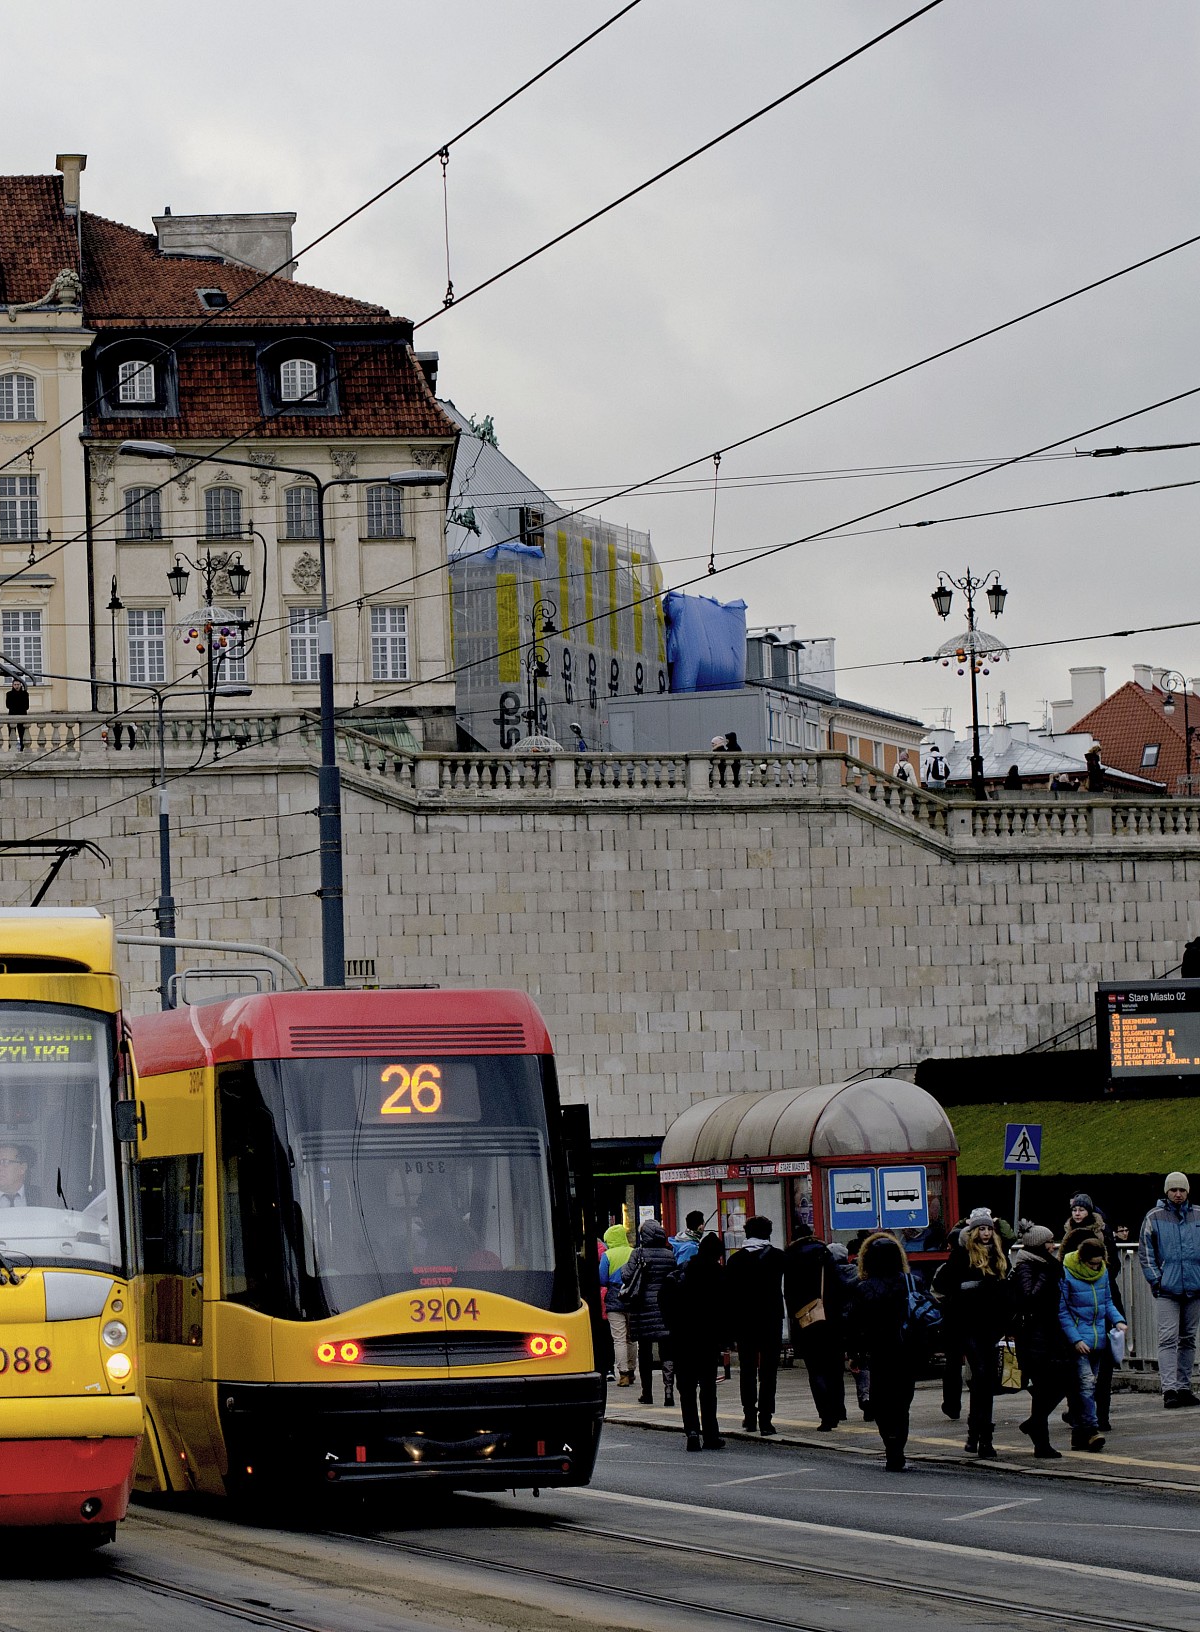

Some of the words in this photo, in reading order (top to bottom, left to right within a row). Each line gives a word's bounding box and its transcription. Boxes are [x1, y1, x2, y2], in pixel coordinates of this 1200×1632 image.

[493, 691, 520, 749] sto
[1128, 993, 1149, 1002] Stare
[1150, 992, 1175, 1001] Miasto
[1176, 992, 1186, 1001] 02
[381, 1064, 441, 1114] 26
[409, 1298, 480, 1322] 3204
